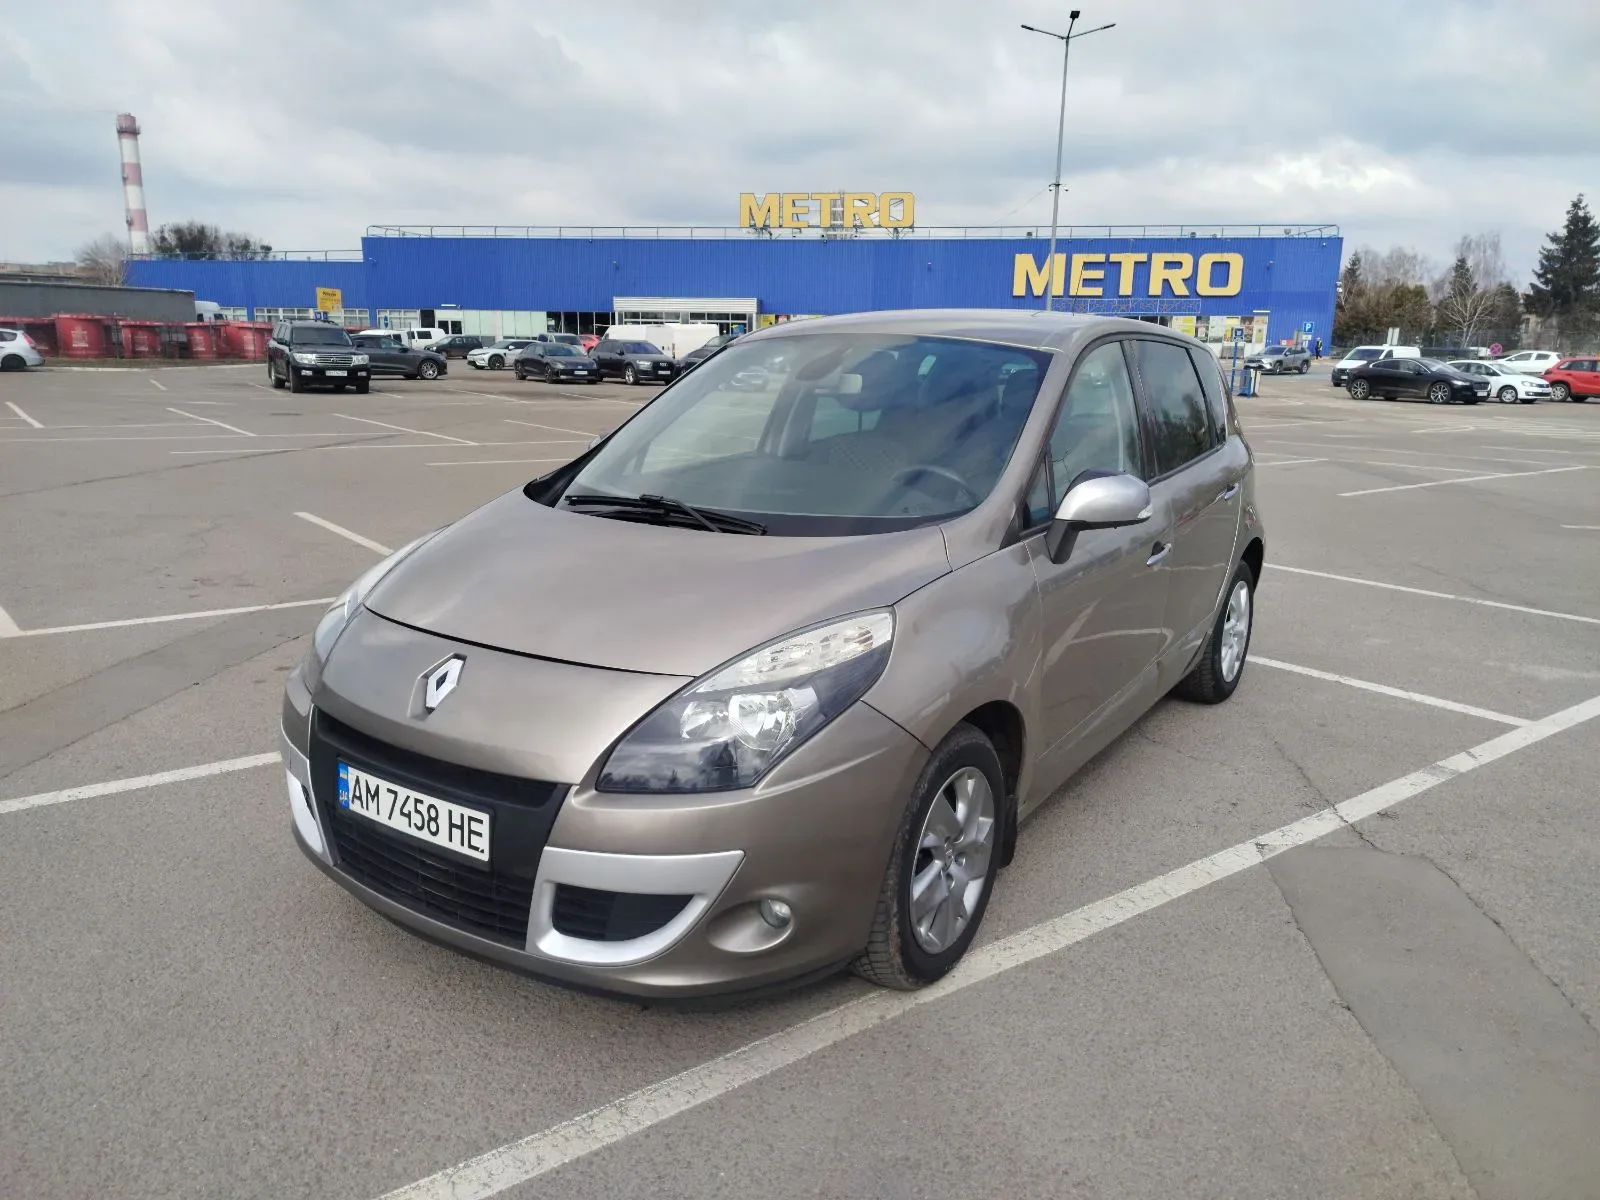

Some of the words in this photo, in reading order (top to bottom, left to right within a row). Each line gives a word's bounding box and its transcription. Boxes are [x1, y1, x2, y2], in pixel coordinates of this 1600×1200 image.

[740, 192, 915, 228] METRO
[1012, 253, 1244, 296] METRO
[351, 775, 380, 815] AM
[386, 788, 440, 837] 7458
[448, 809, 485, 854] HE
